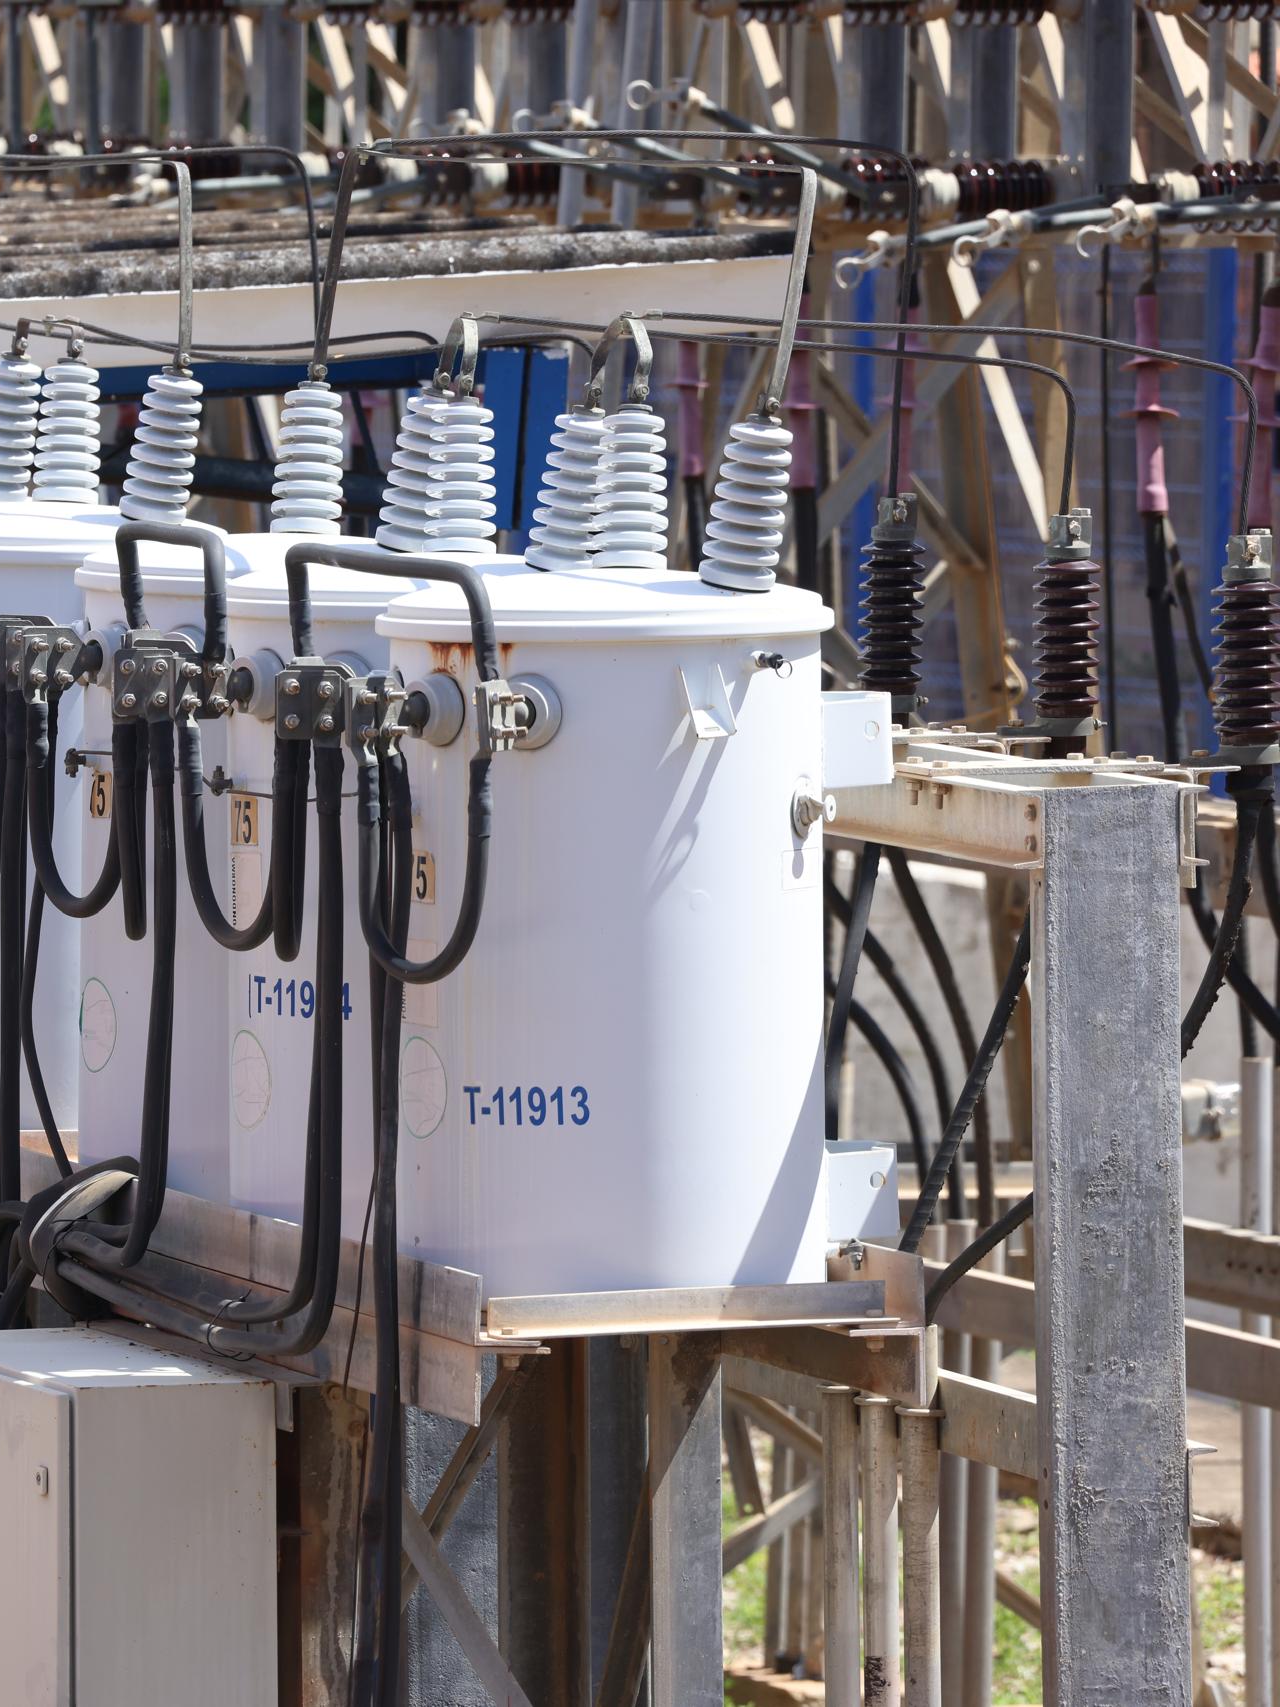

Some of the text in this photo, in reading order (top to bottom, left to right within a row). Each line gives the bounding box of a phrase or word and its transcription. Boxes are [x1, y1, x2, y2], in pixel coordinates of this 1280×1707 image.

[233, 800, 252, 844] 75
[415, 855, 428, 900] 5
[253, 975, 353, 1021] T-1194
[463, 1085, 591, 1127] T-11913
